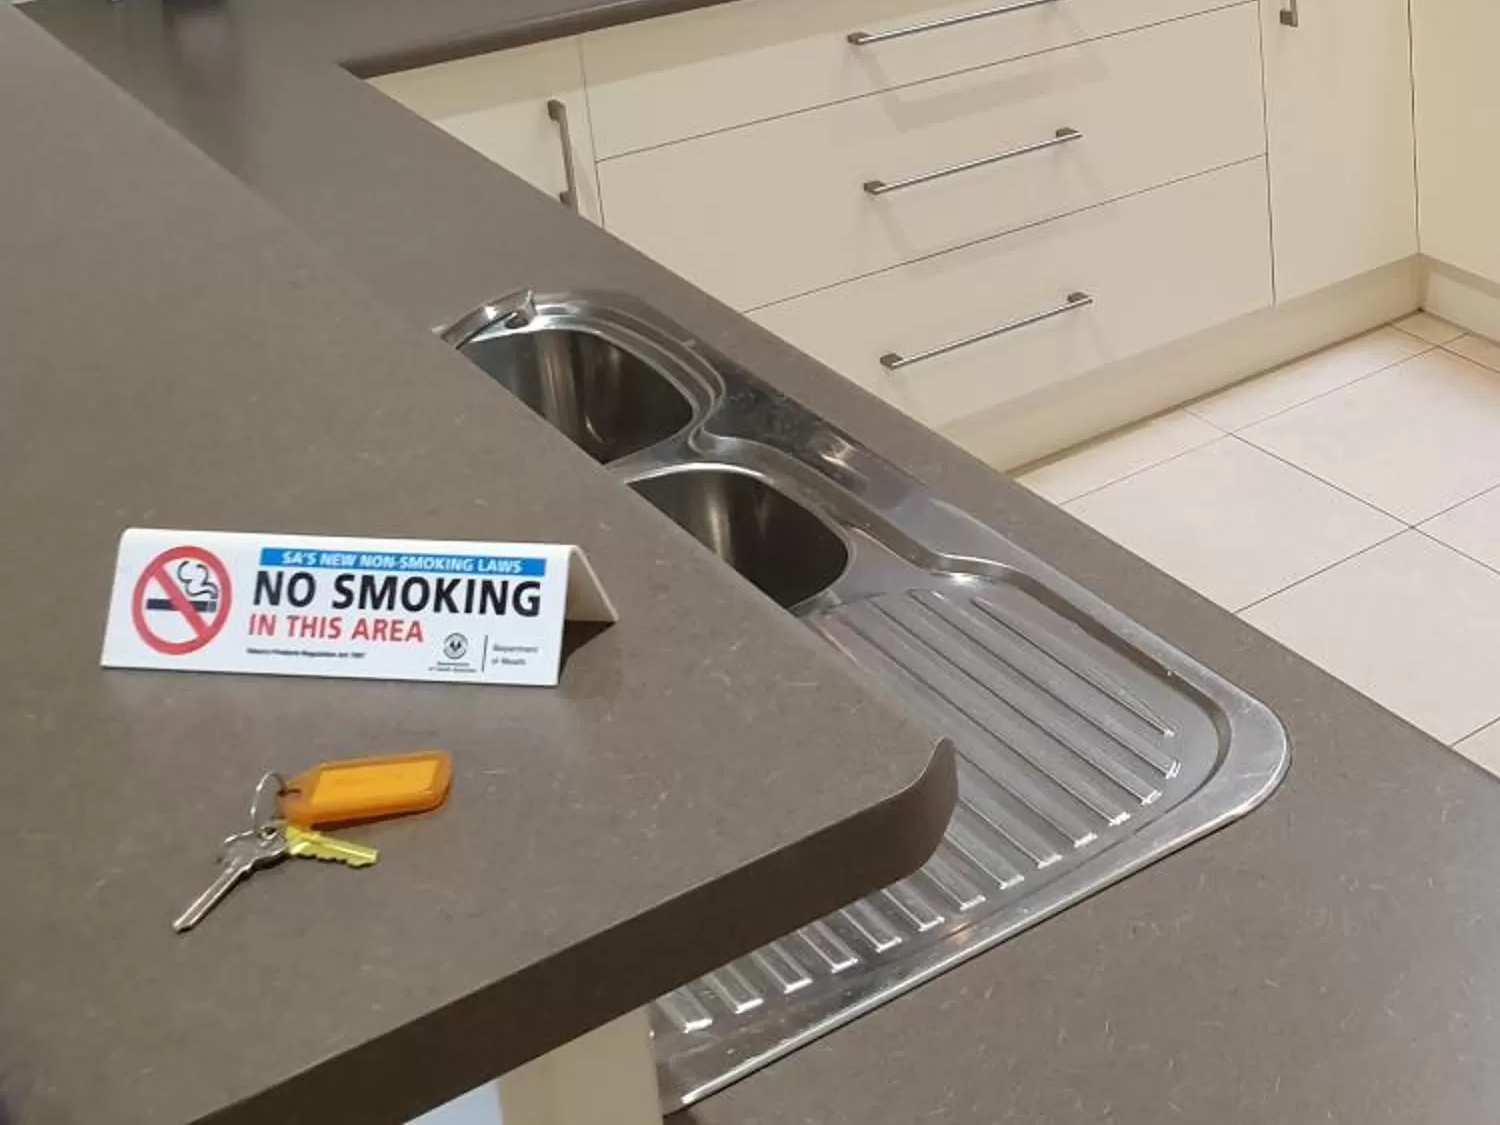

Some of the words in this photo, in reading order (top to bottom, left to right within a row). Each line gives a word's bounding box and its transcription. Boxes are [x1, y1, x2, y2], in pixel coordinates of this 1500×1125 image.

[282, 550, 316, 565] SA'S
[320, 553, 355, 567] NEW
[359, 554, 473, 572] NON-SMOKING
[477, 558, 522, 573] LAWS
[253, 570, 316, 608] NO
[331, 573, 541, 618] SMOKING
[248, 613, 277, 637] IN
[286, 615, 342, 640] THIS
[351, 618, 424, 643] AREA
